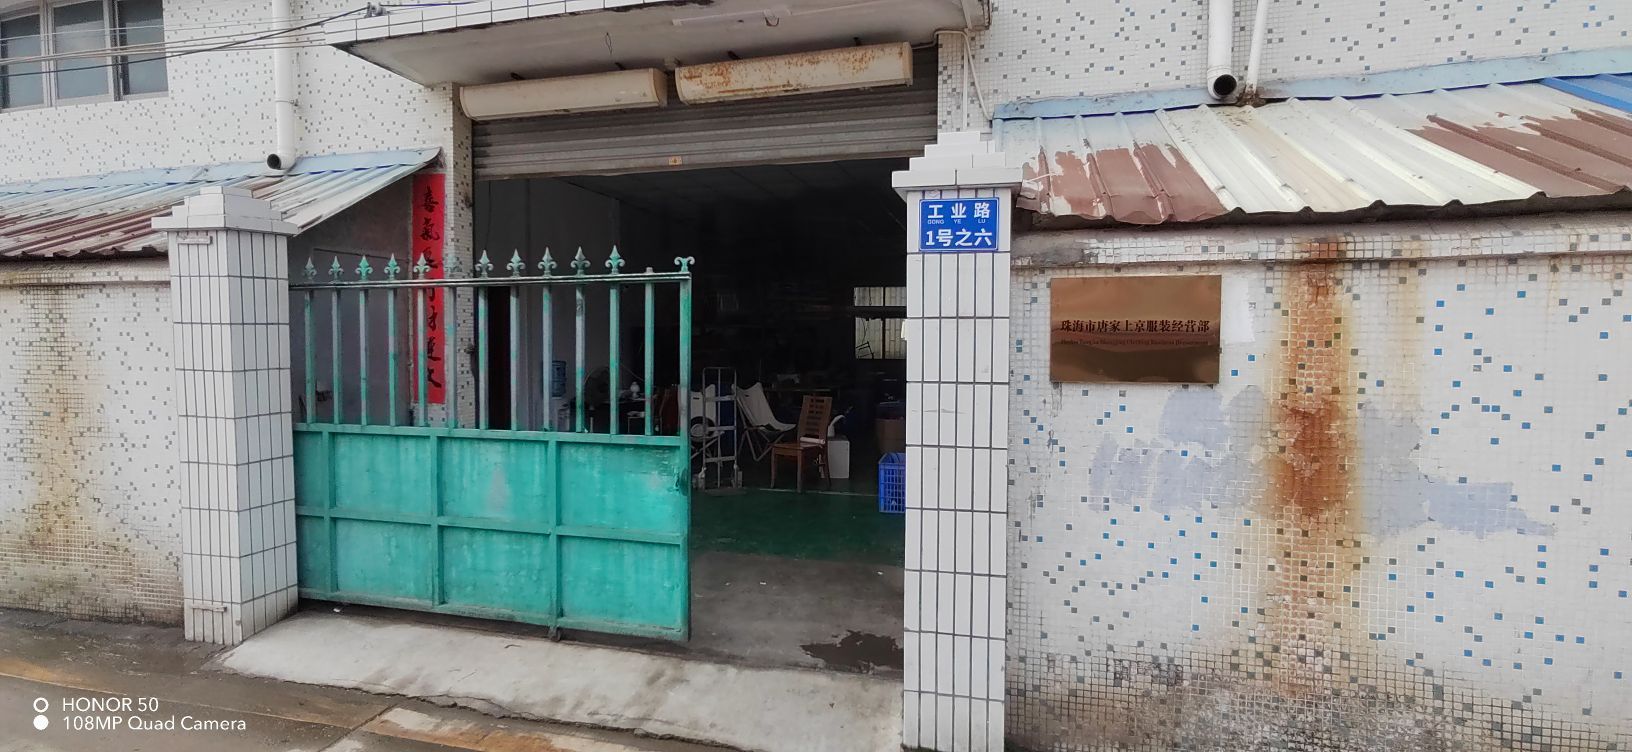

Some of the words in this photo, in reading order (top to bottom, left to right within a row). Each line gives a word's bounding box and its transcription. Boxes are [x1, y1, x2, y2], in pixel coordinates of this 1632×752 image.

[927, 202, 991, 218] 工业路
[925, 228, 993, 247] 1号之六
[1060, 319, 1210, 333] 珠海市唐家上京服装经营部
